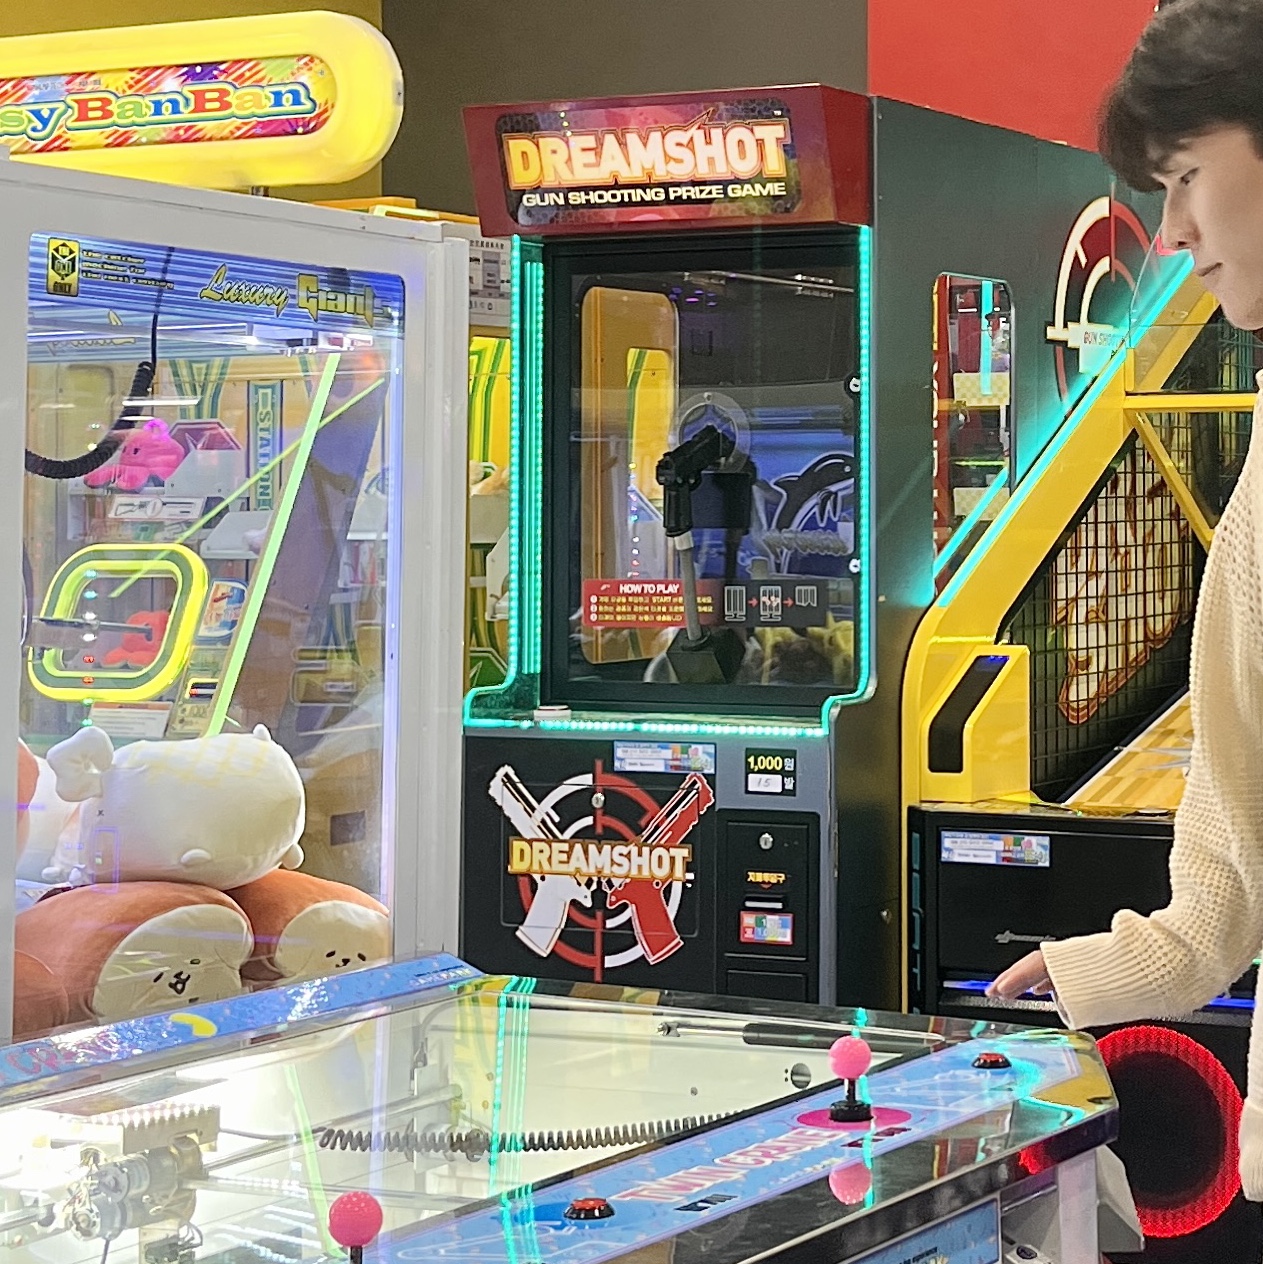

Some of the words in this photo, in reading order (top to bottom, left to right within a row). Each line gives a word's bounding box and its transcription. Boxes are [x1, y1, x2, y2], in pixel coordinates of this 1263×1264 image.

[503, 117, 789, 188] DREAMSHOT
[522, 192, 564, 207] GUN
[568, 187, 665, 206] SHOOTING
[669, 183, 724, 200] PRIZE
[726, 181, 787, 197] GAME
[200, 262, 289, 318] Luxury
[619, 584, 640, 593] HOW
[641, 584, 656, 594] TO
[656, 584, 679, 594] PLAY
[508, 837, 692, 880] DREAMSHOT
[610, 1164, 750, 1203] TWIN
[714, 1128, 850, 1168] CRANE
